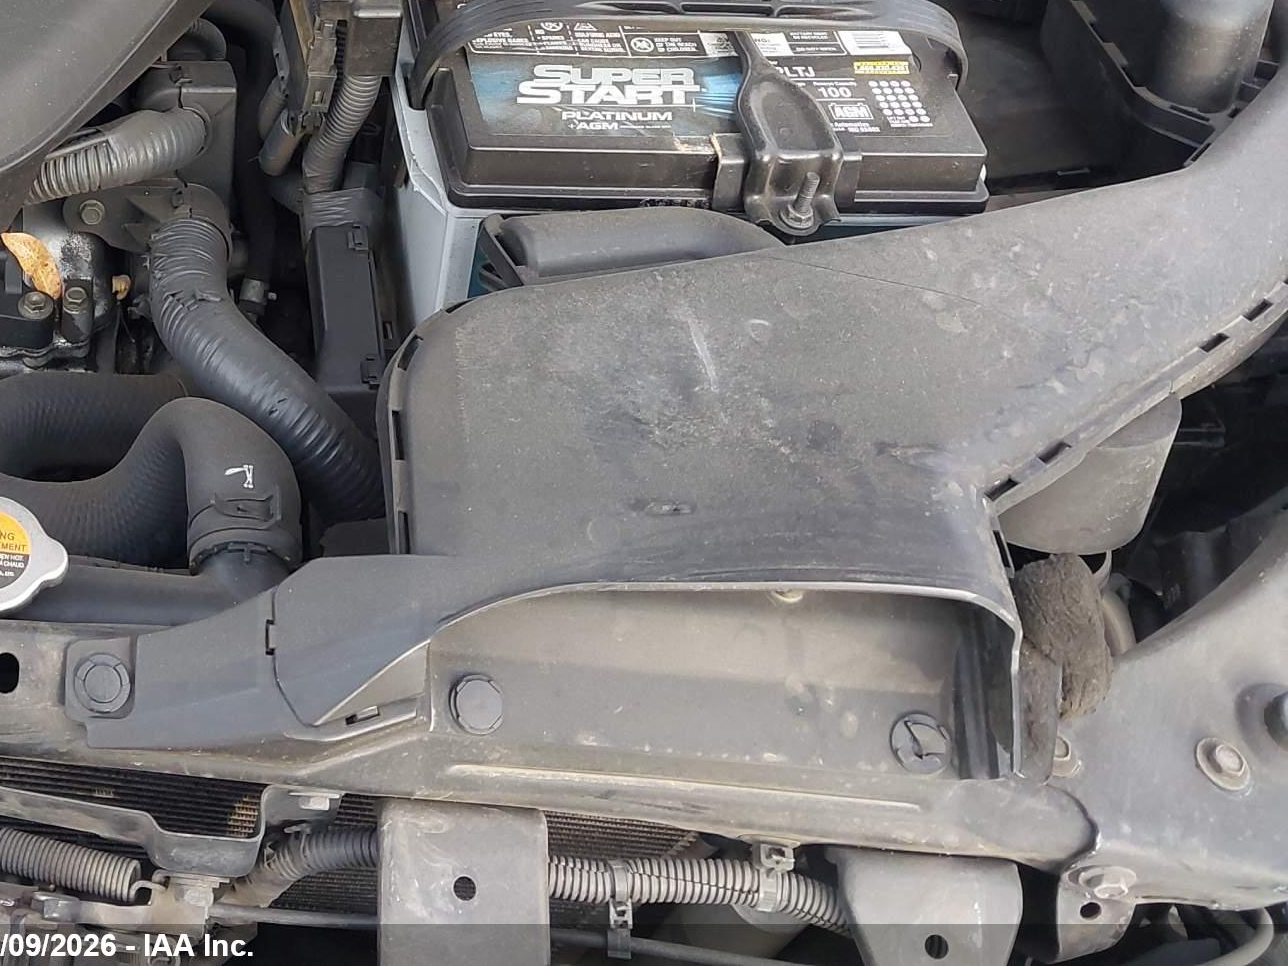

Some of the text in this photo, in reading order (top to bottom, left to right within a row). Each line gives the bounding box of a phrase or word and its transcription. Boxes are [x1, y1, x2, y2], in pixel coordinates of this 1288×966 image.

[533, 64, 695, 85] SUPER
[516, 79, 700, 105] START
[817, 87, 852, 98] 100
[562, 111, 673, 121] PLATINUM
[834, 105, 871, 118] AGM
